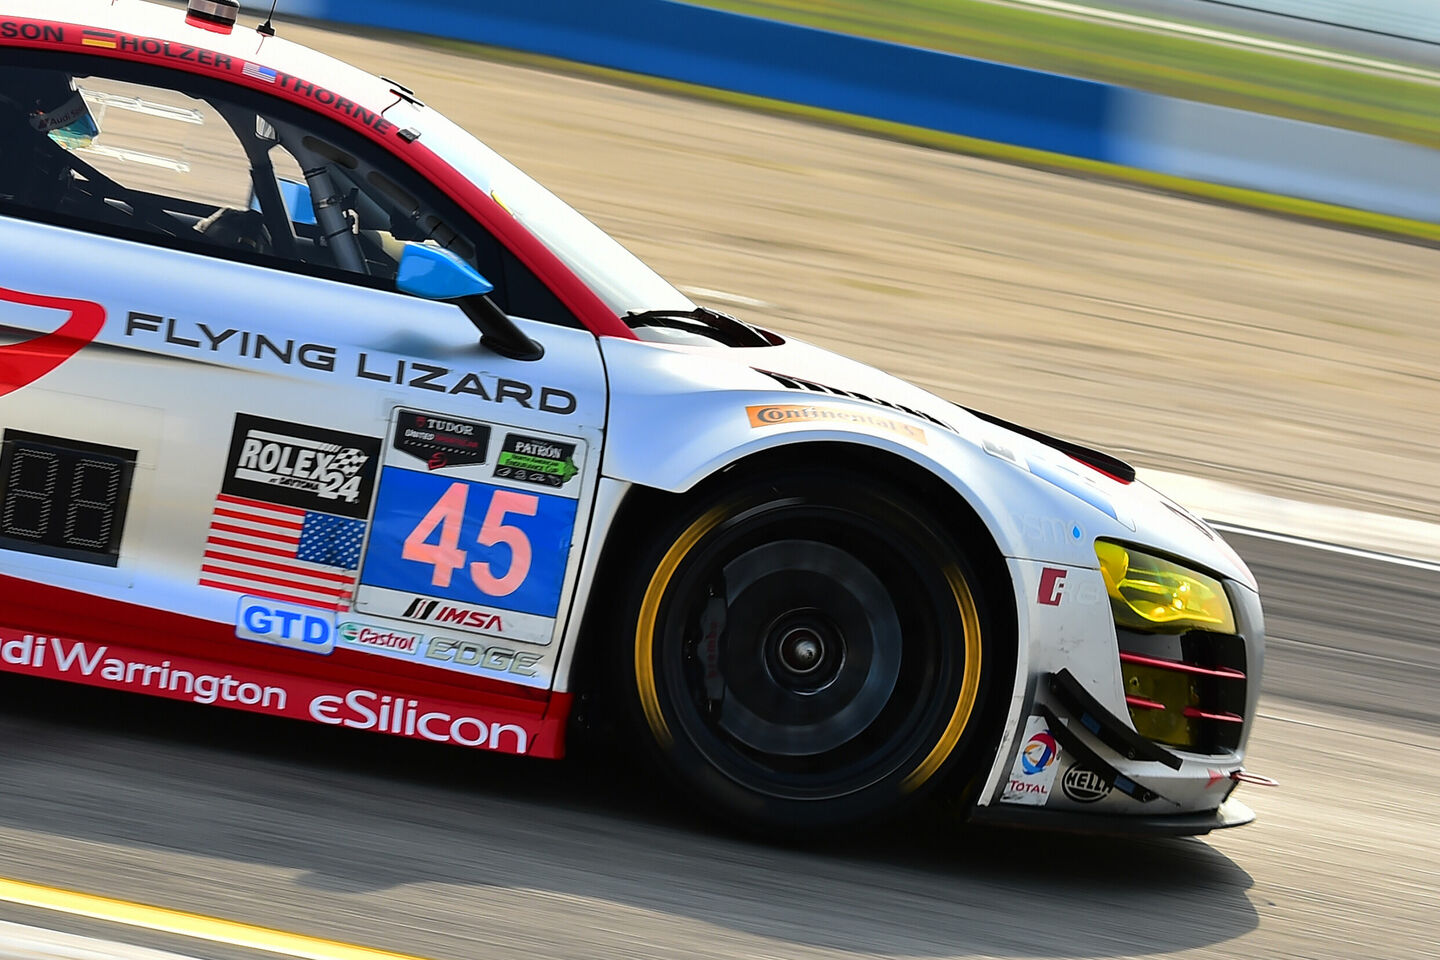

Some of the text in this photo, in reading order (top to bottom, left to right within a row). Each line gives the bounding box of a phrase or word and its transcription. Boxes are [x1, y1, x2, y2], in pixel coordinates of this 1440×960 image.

[120, 36, 232, 70] HOLZER
[280, 74, 393, 135] THORNE
[124, 310, 578, 416] FLYING LIZARD
[427, 418, 474, 436] TUDOR
[238, 438, 335, 482] ROLEX
[317, 471, 362, 503] 24
[401, 482, 540, 597] 45
[243, 605, 330, 645] GTD
[434, 606, 503, 632] IMSA
[51, 638, 287, 710] Warrington
[359, 627, 544, 677] Castrol EDGE
[309, 689, 528, 754] eSilicon
[1009, 780, 1048, 794] TOTAL
